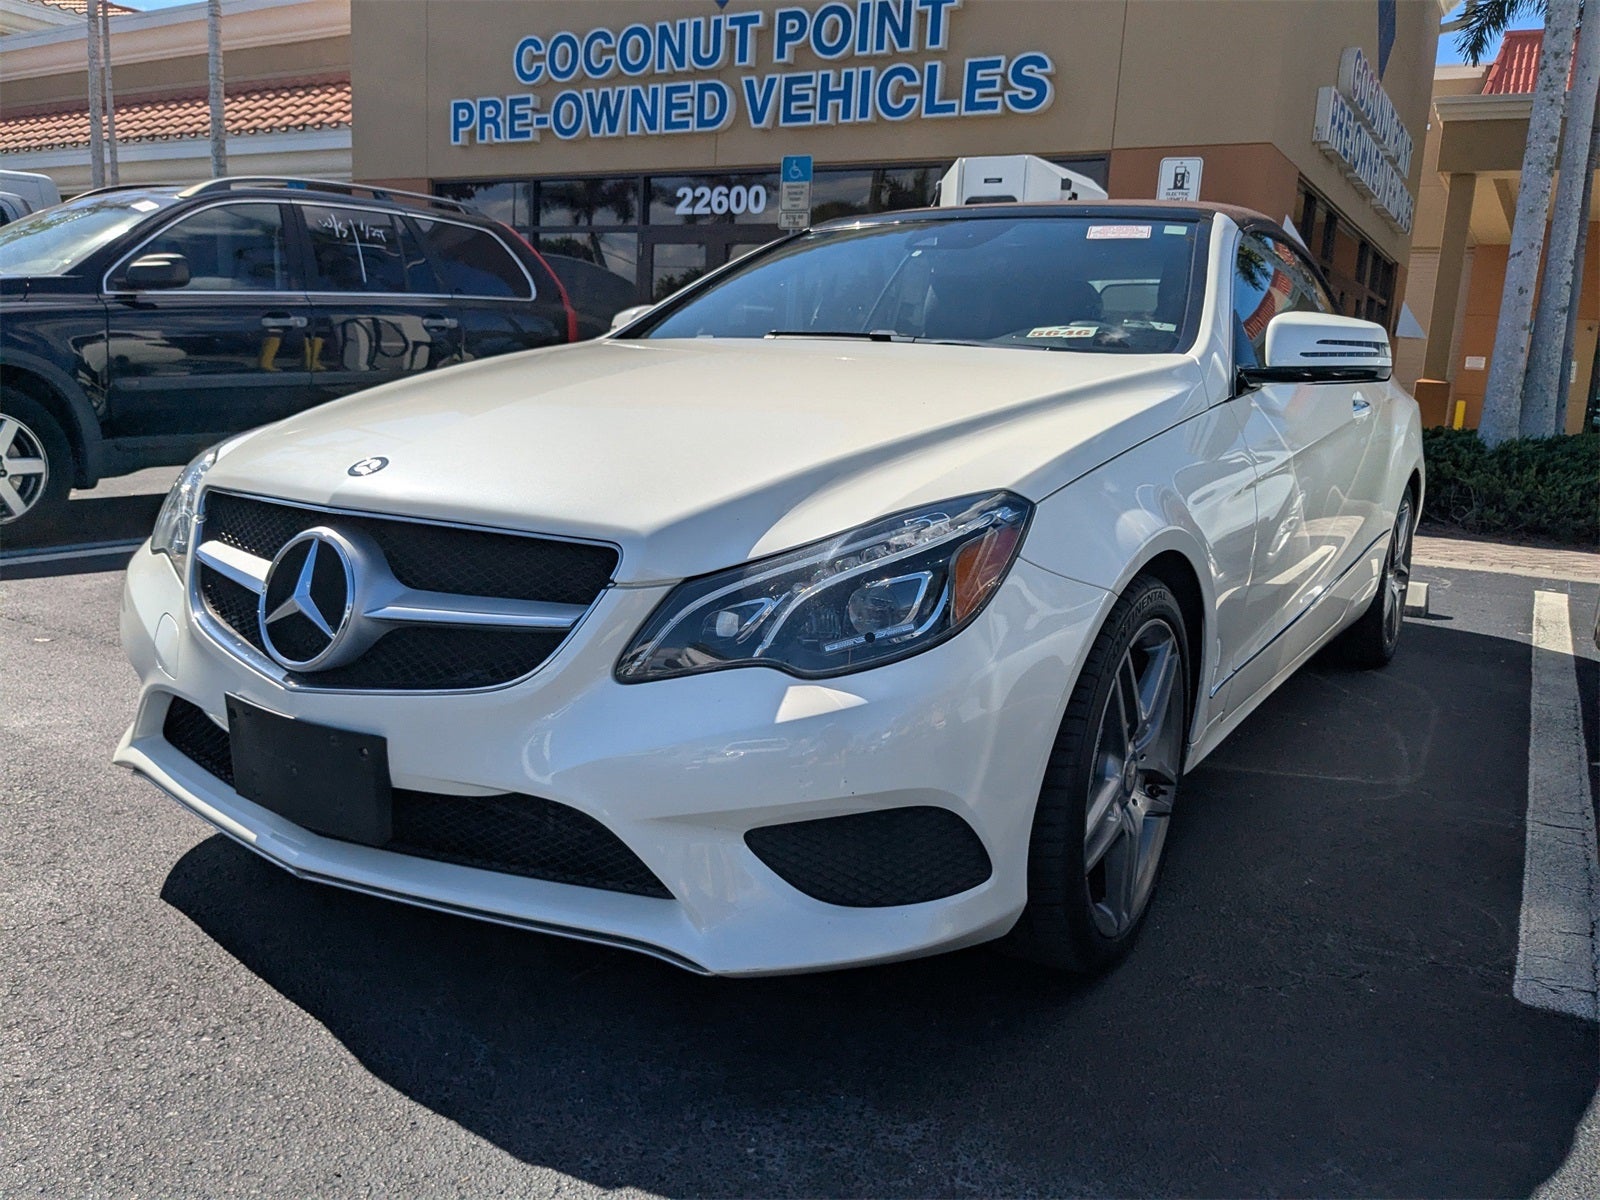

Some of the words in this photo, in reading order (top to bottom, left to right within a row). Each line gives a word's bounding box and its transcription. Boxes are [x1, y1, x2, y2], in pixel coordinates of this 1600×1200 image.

[513, 11, 764, 86] COCONUT
[773, 0, 959, 64] POINT
[450, 79, 735, 146] PRE-OWNED
[741, 52, 1056, 130] VEHICLES
[675, 185, 767, 215] 22600
[1030, 328, 1092, 338] 5646
